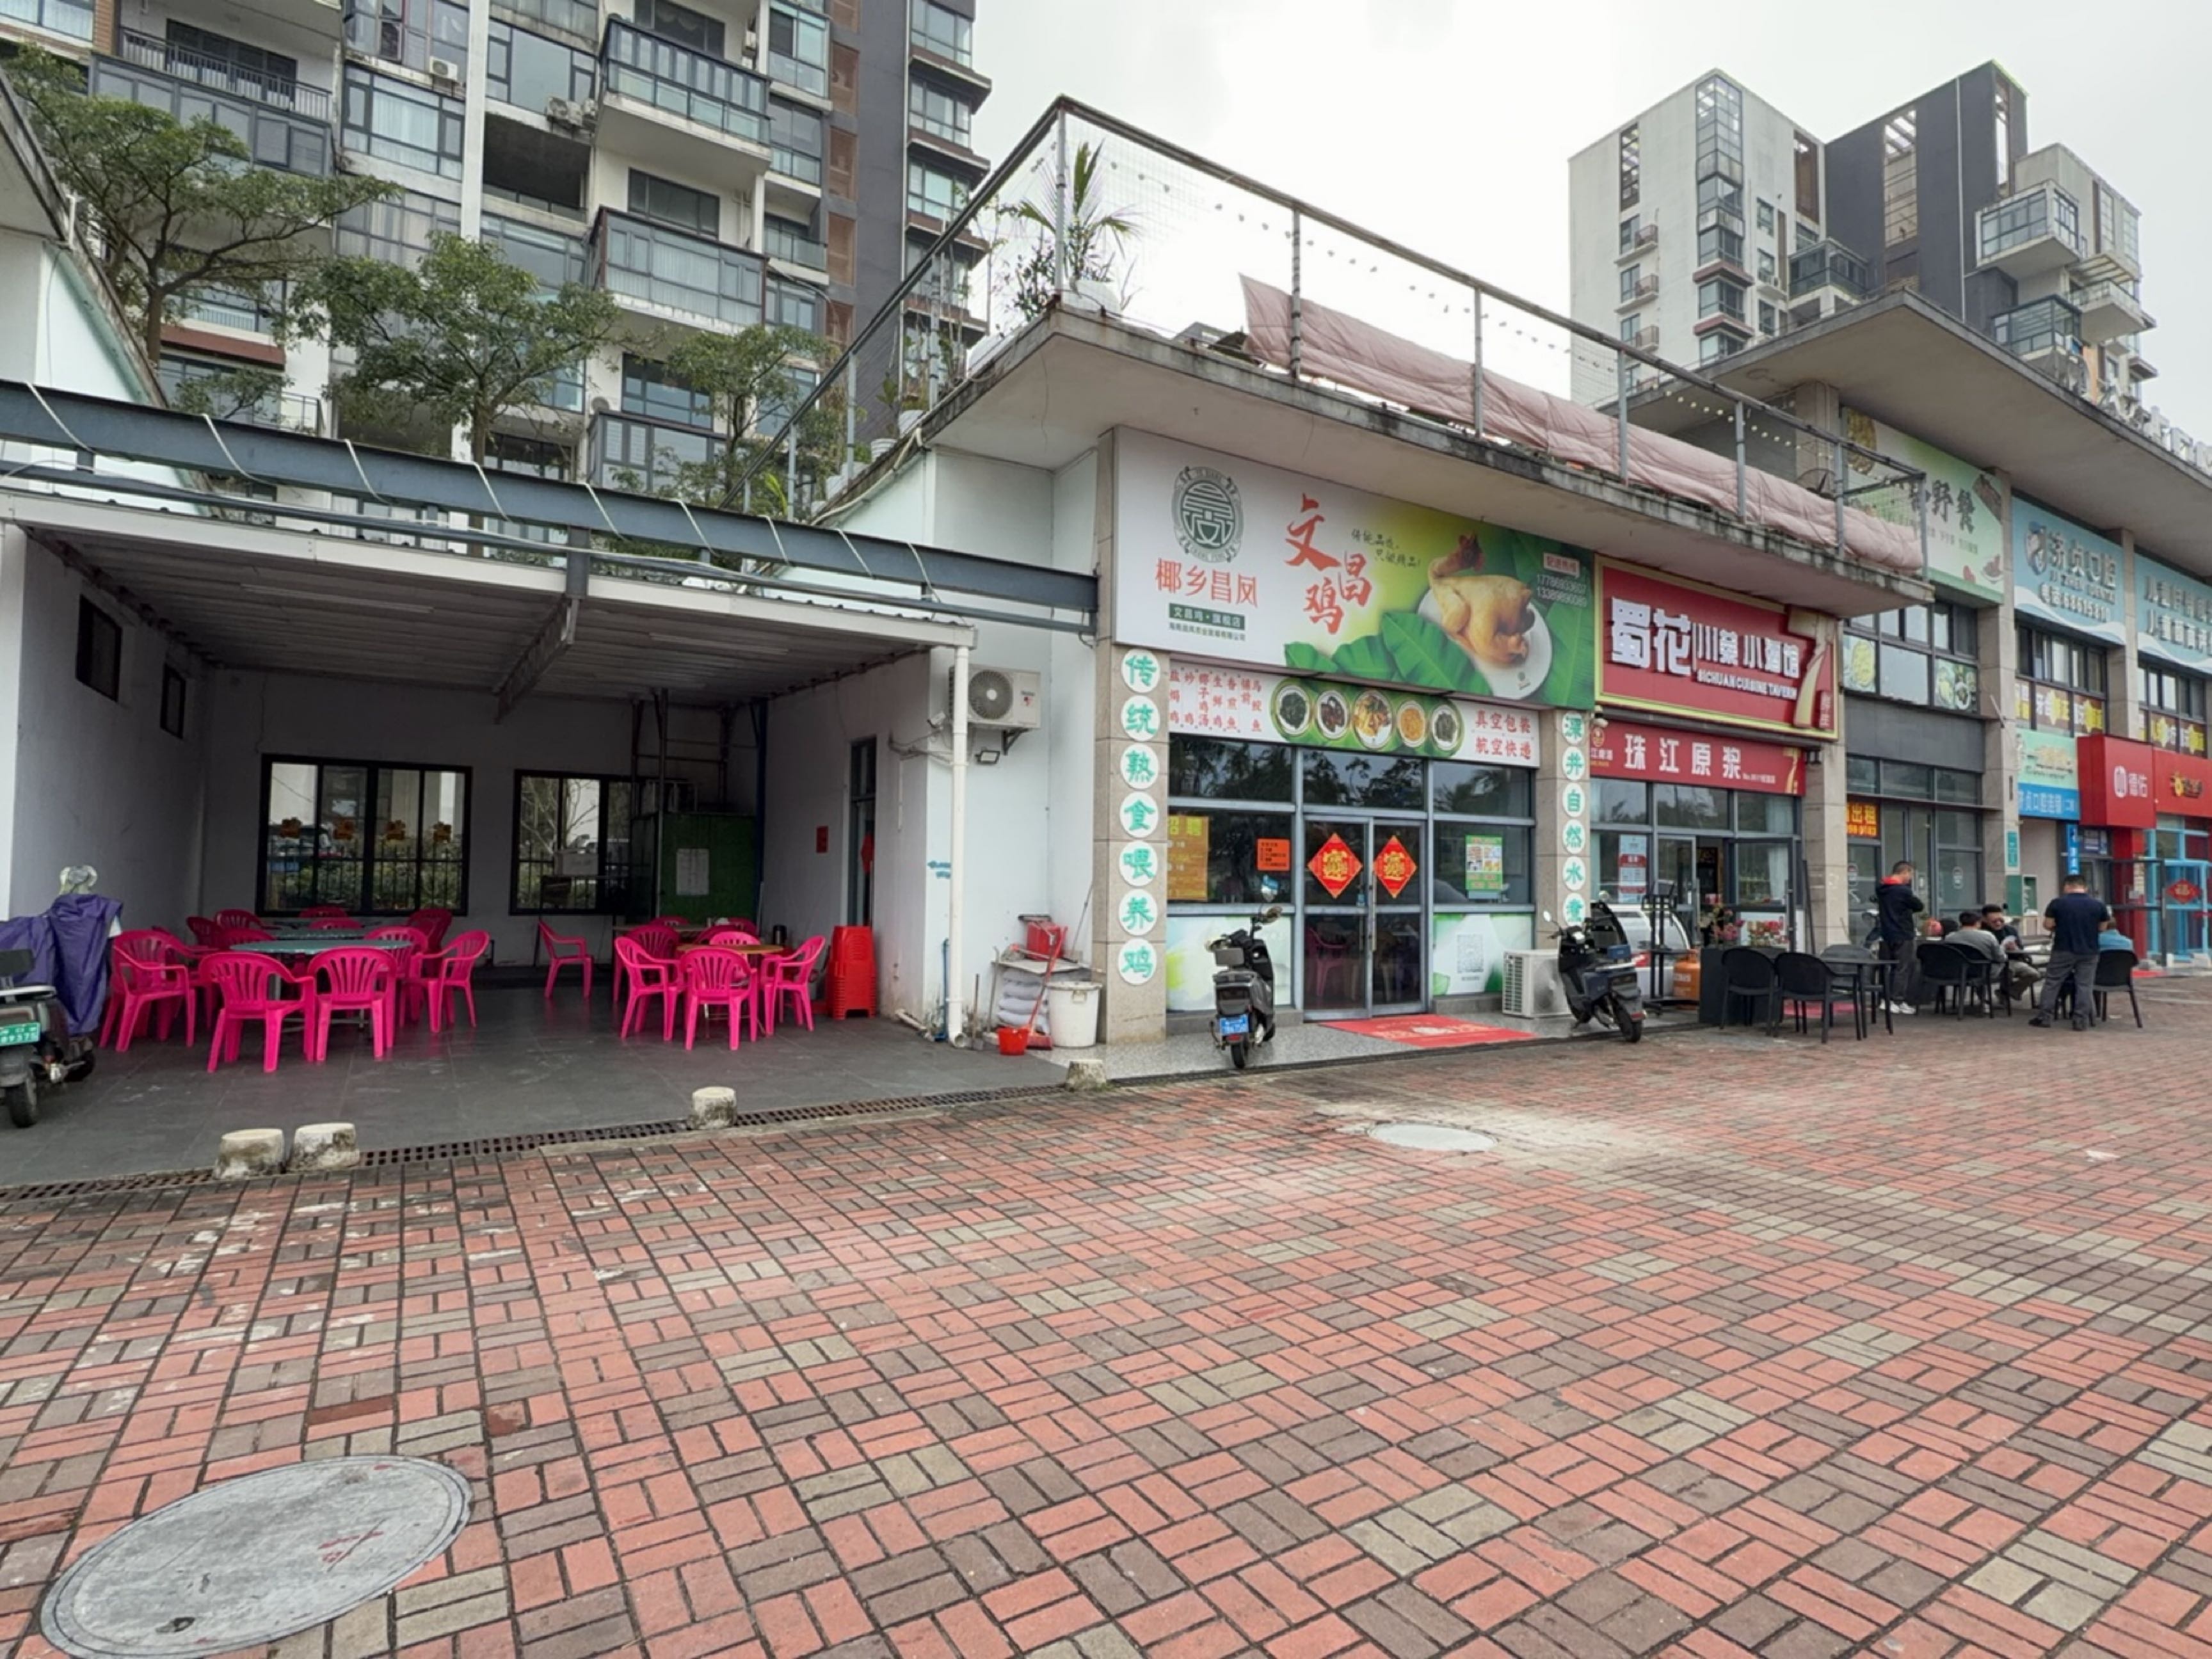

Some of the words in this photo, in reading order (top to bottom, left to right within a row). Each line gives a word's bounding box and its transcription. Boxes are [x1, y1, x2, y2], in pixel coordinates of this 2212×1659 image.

[1475, 709, 1531, 733] 真空包装
[1475, 735, 1532, 760] 航空快递
[1624, 733, 1742, 779] 珠江原浆
